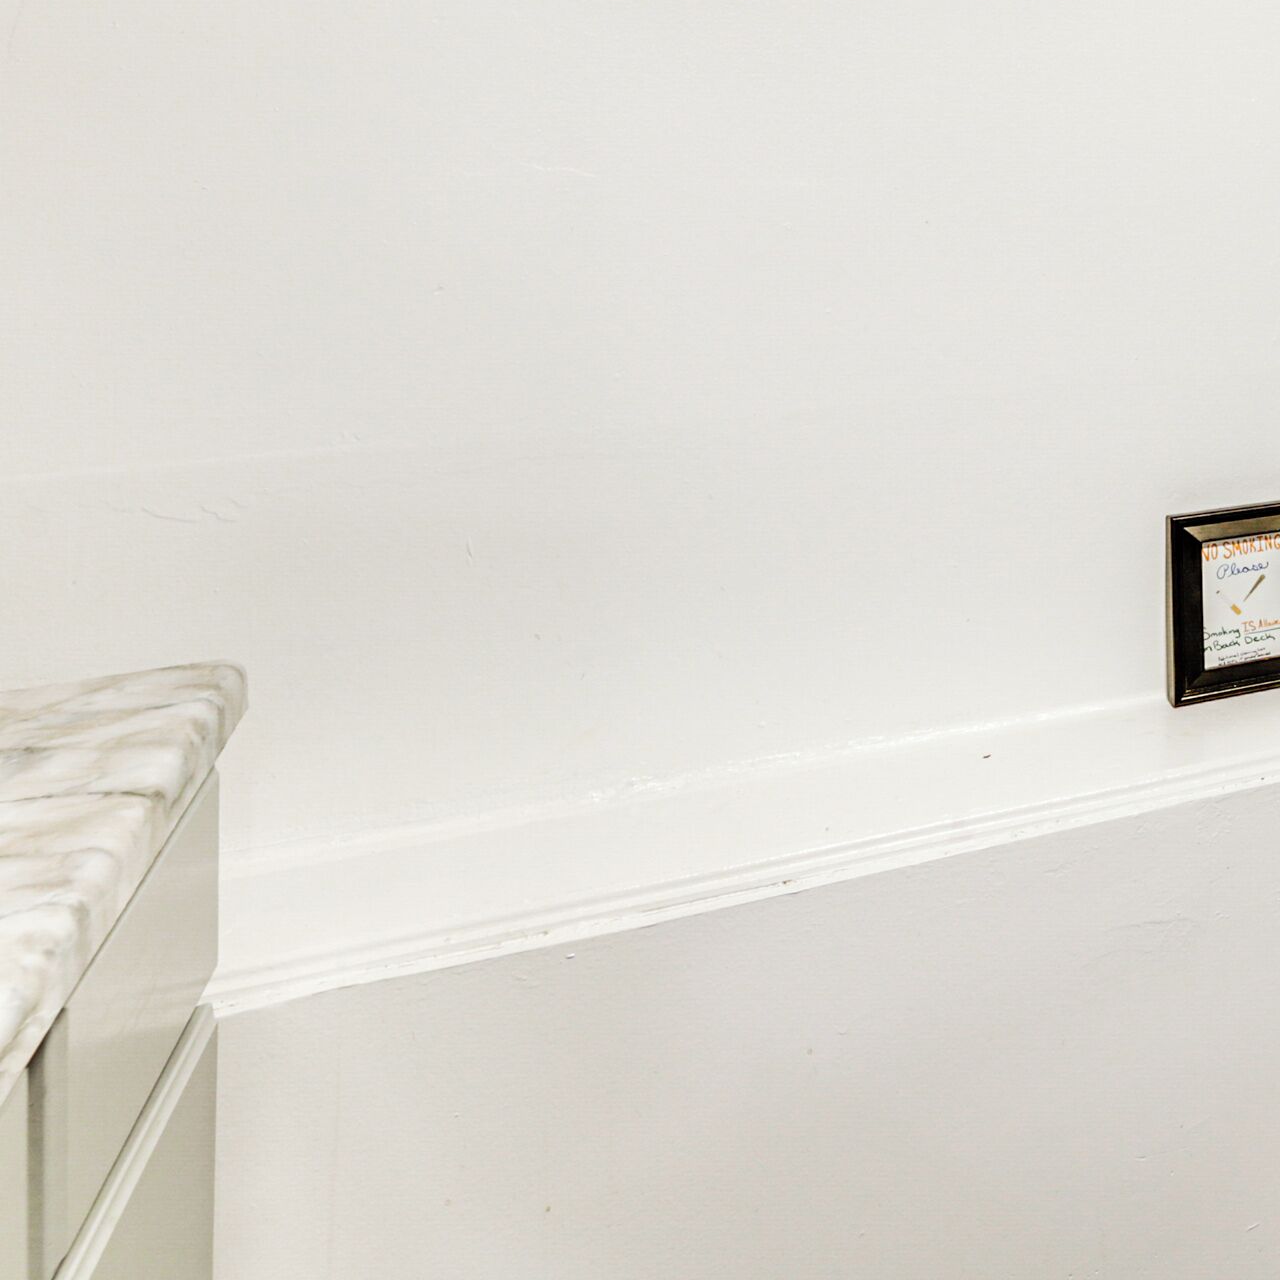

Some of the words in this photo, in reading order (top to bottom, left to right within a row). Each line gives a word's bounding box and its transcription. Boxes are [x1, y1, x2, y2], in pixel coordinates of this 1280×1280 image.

[1216, 561, 1269, 580] Please
[1213, 640, 1241, 652] Back
[1244, 633, 1276, 645] Deck
